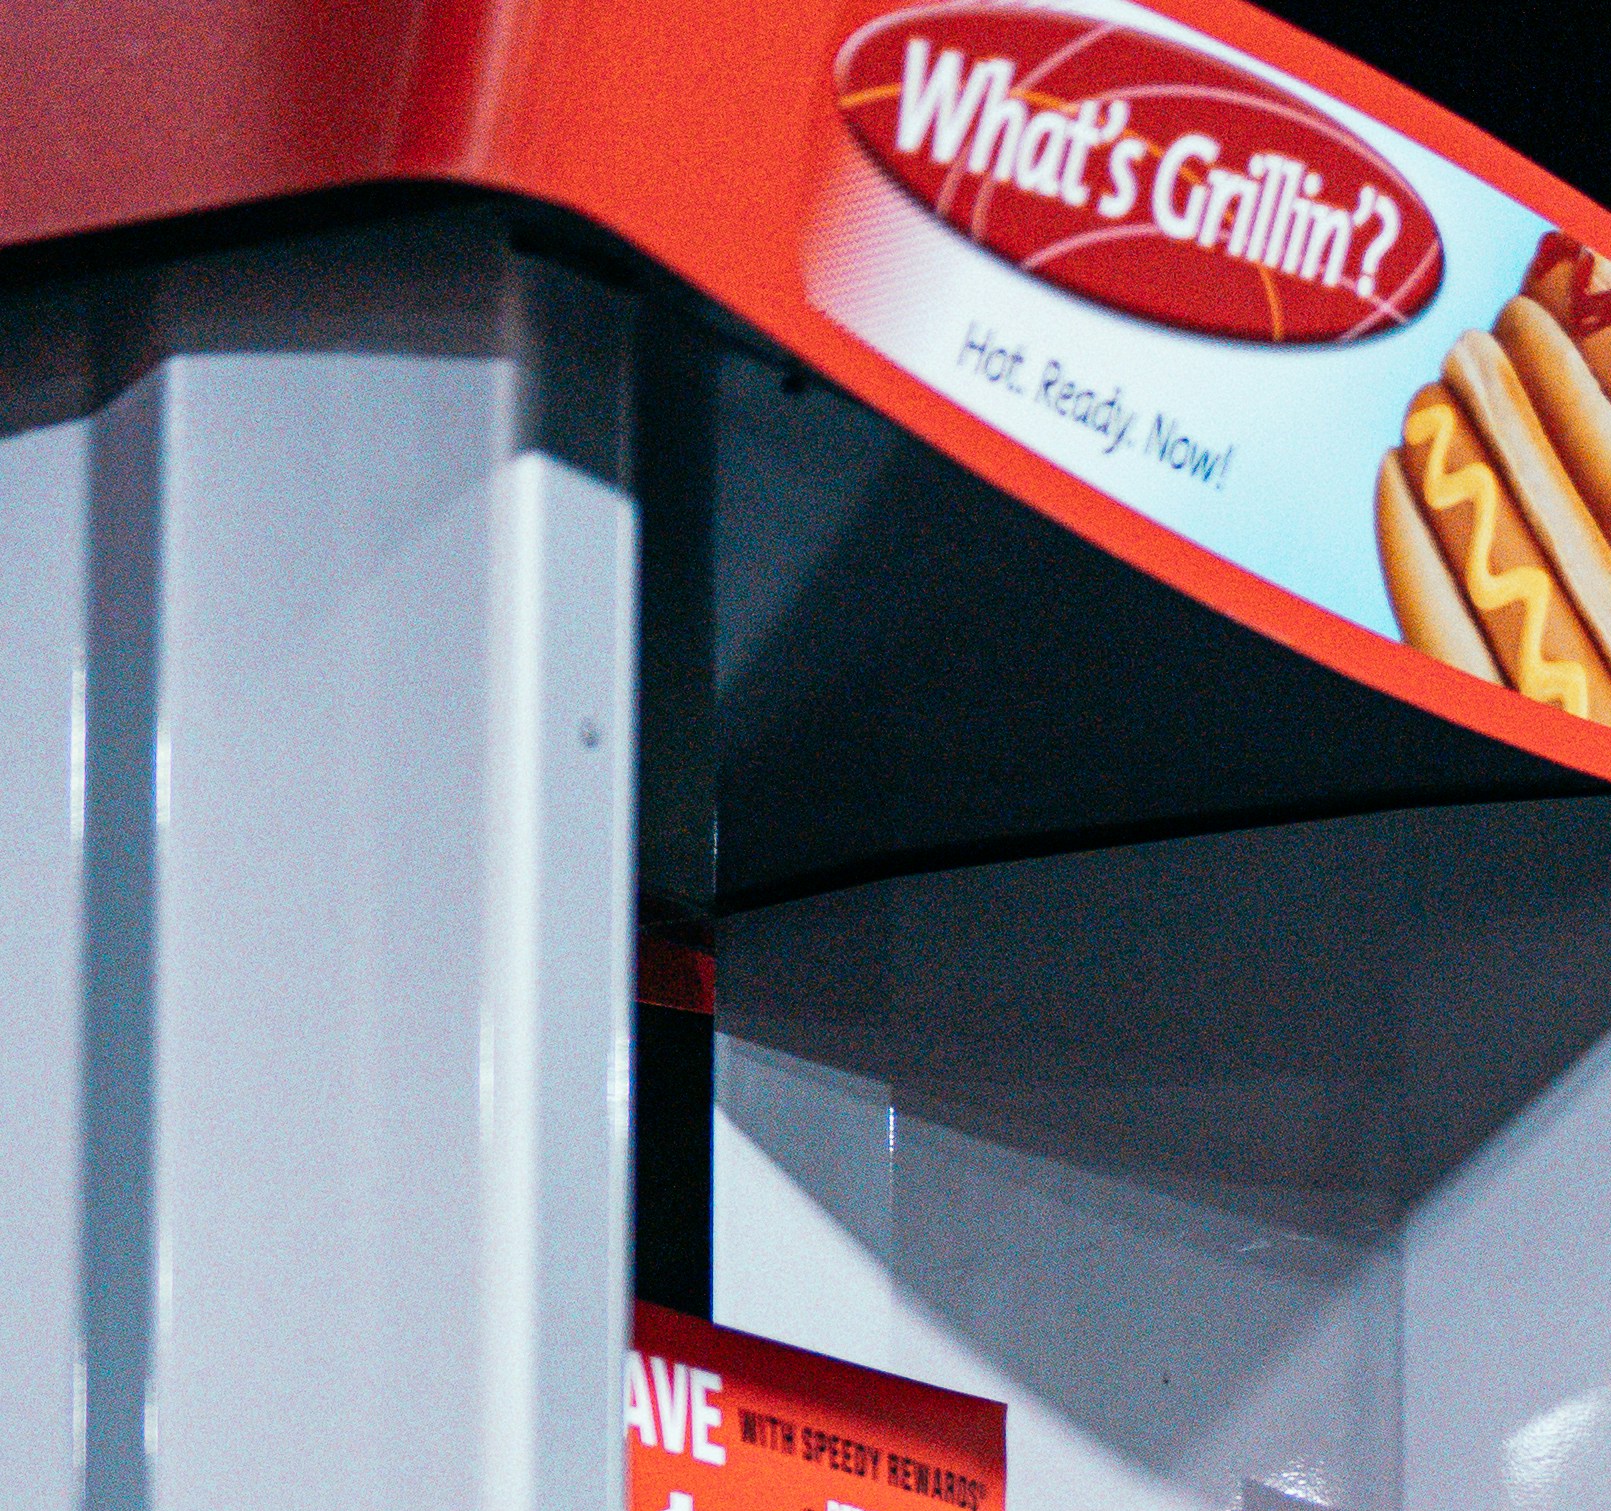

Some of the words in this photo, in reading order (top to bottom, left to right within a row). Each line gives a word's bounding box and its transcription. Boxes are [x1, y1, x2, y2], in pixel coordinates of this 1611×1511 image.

[895, 37, 1147, 217] What's
[1153, 133, 1400, 298] Grillin'?
[955, 322, 1023, 395] Hot.
[1035, 358, 1136, 454] Ready.
[1144, 414, 1237, 491] Now!
[738, 1407, 796, 1454] WITH
[801, 1427, 882, 1481] SPEEDY
